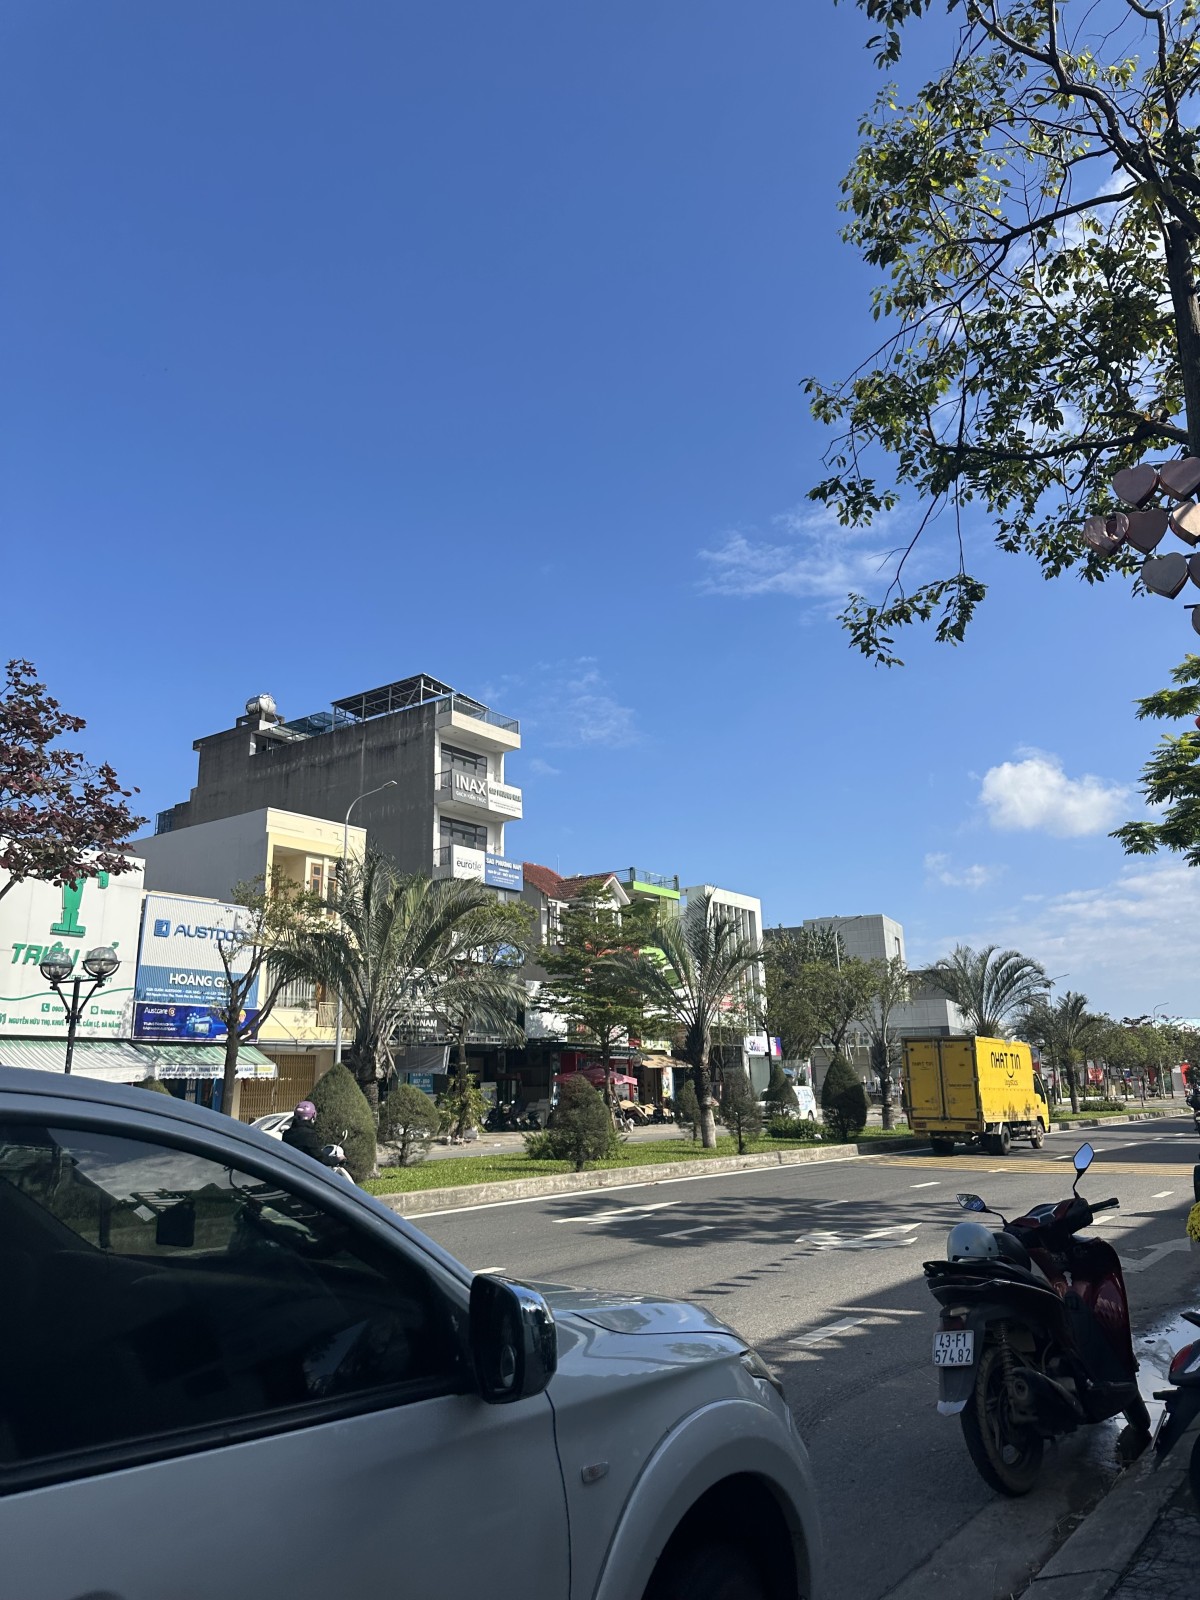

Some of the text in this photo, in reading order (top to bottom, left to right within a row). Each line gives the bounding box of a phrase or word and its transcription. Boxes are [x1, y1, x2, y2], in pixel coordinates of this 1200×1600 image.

[455, 773, 487, 796] INAX
[174, 923, 256, 943] AUSTDOO
[169, 972, 231, 989] HOÀNG GI
[420, 1019, 438, 1027] NAM
[939, 1333, 967, 1349] 43-F1
[935, 1348, 971, 1364] 574.82
